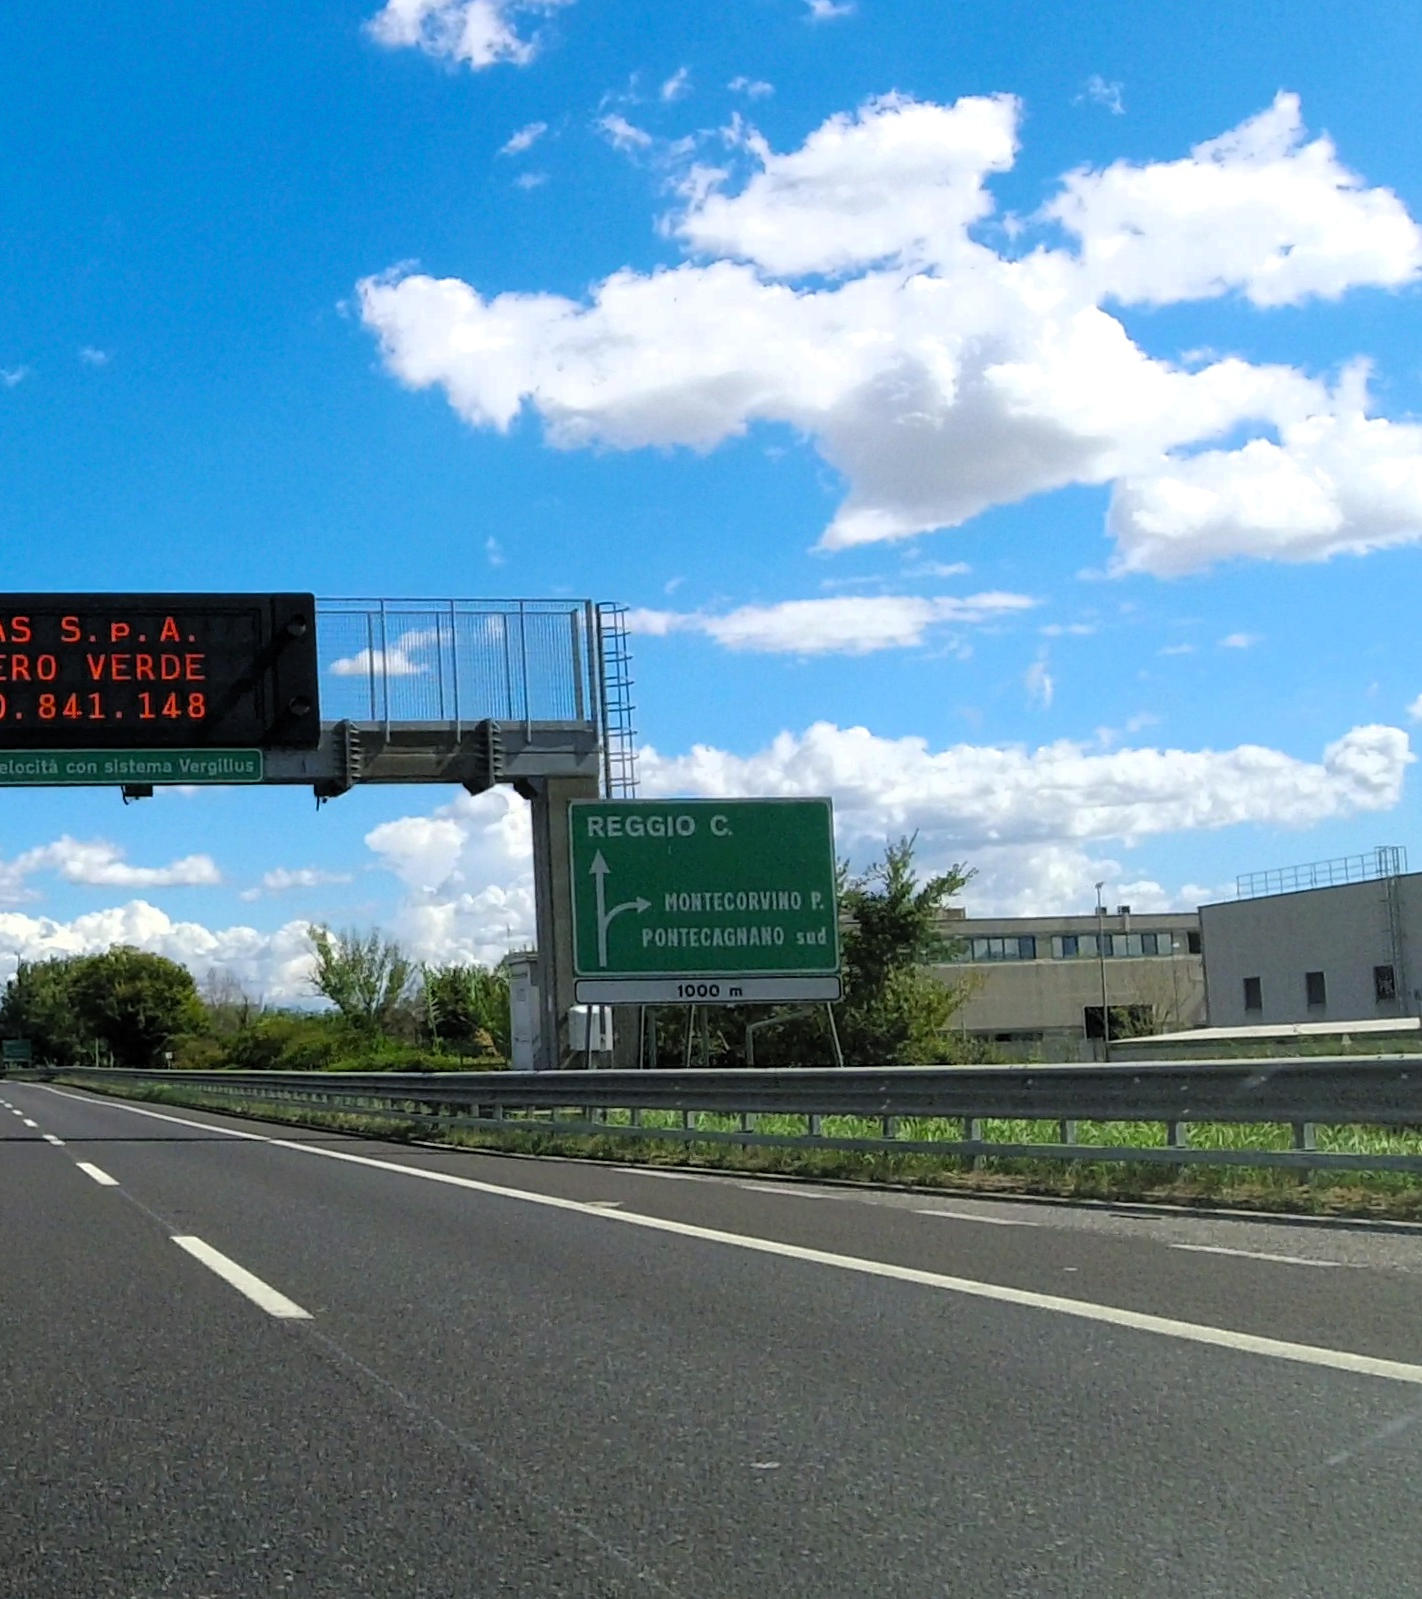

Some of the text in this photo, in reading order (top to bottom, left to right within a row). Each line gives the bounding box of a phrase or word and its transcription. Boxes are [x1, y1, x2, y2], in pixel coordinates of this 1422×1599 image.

[61, 616, 197, 643] S.p.A.
[86, 653, 206, 681] VERDE
[66, 762, 97, 774] con
[104, 758, 172, 774] sistema
[179, 757, 254, 776] Vergilius
[587, 814, 733, 838] REGGIO C.
[664, 891, 825, 912] MONTECORVINO P.
[642, 926, 827, 948] PONTECAGNANO sud
[677, 984, 743, 998] 1000 m
